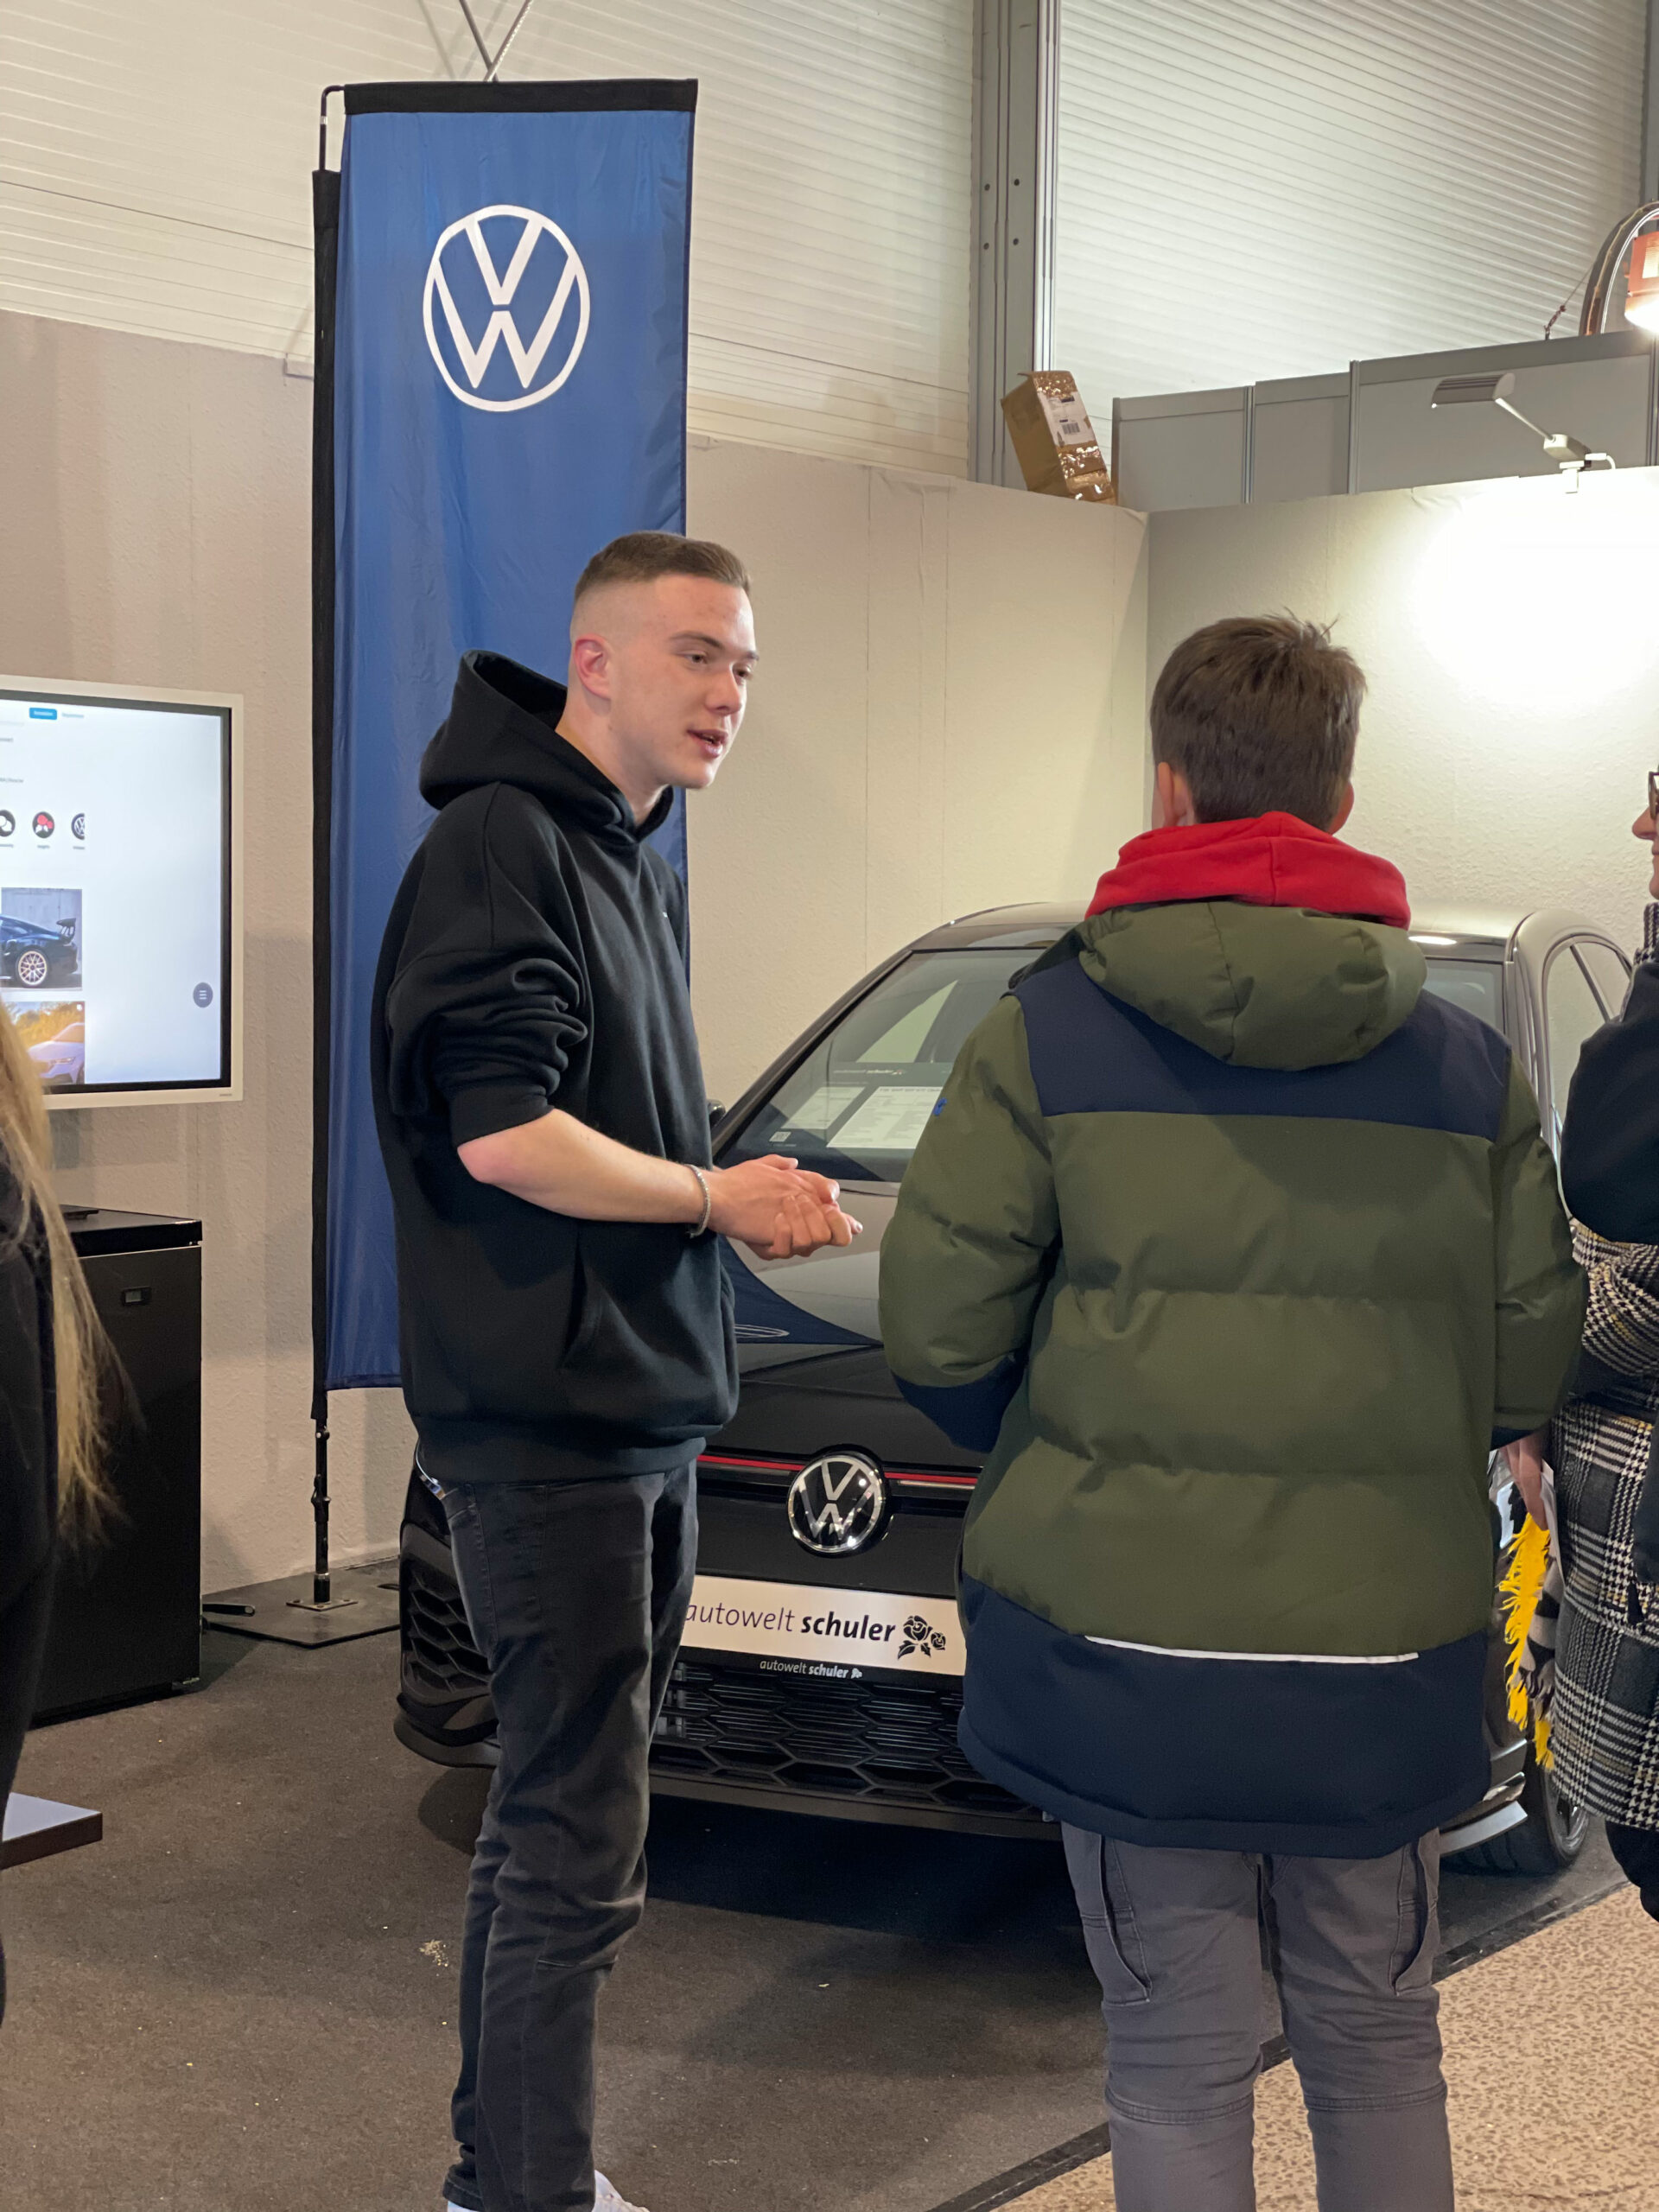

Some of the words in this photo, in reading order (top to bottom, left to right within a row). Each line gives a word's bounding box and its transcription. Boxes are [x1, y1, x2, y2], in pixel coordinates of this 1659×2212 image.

[433, 218, 577, 389] VW
[685, 1602, 796, 1632] autowelt
[800, 1611, 896, 1643] schuler
[760, 1659, 807, 1675] autowelt
[808, 1663, 849, 1679] schuler
